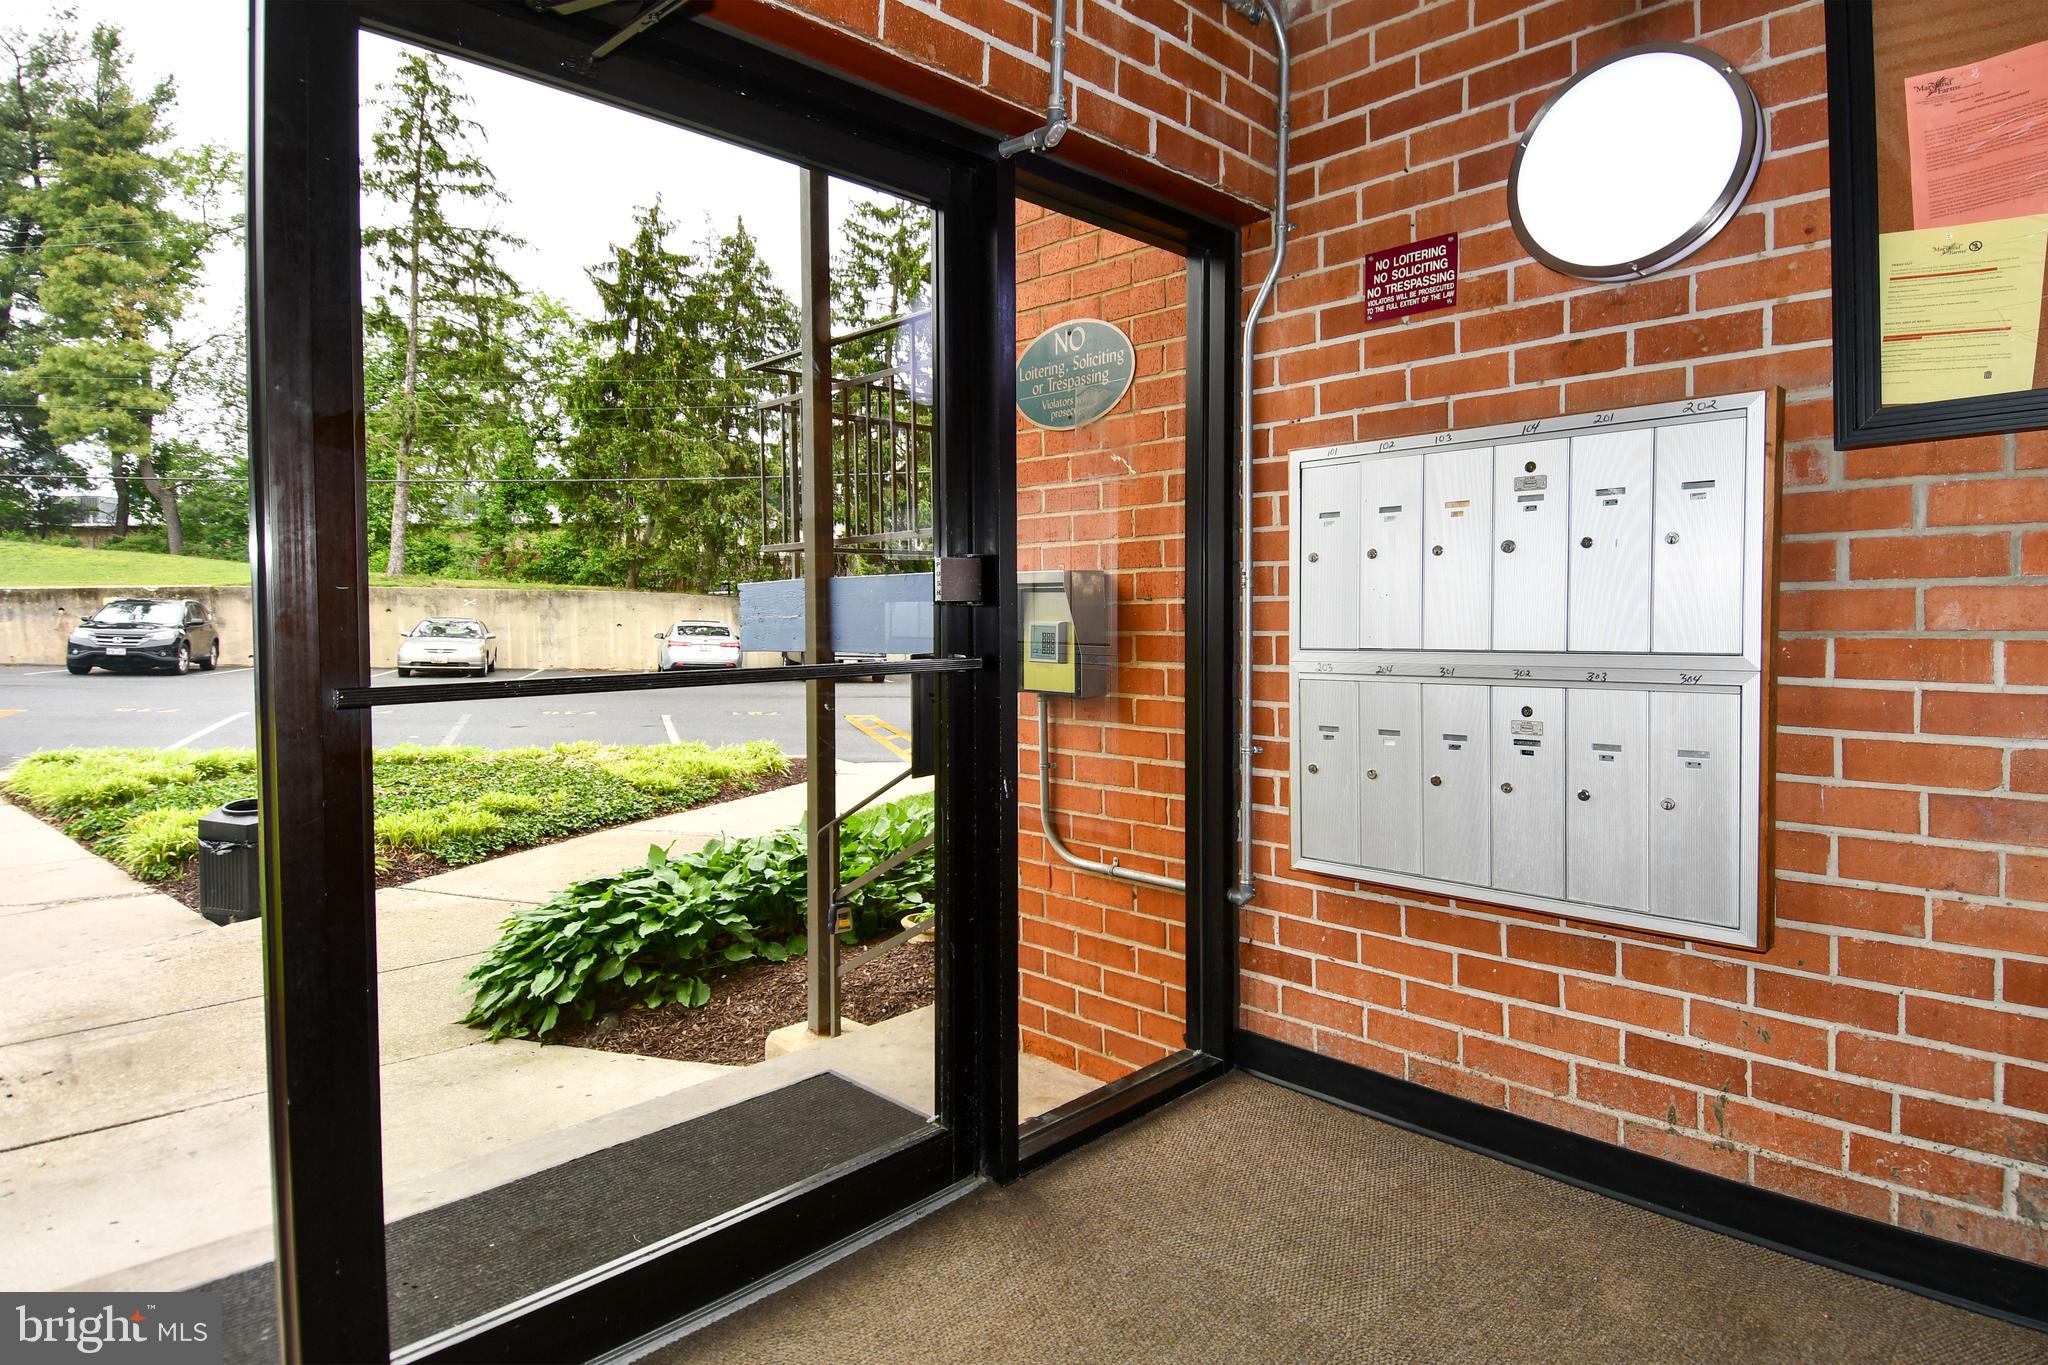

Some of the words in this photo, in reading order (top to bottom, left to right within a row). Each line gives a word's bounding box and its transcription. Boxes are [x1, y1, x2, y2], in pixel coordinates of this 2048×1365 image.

[1375, 258, 1390, 272] NO
[1393, 244, 1447, 267] LOITERING
[1373, 272, 1388, 285] NO
[1391, 257, 1449, 281] SOLICITING
[1367, 286, 1382, 299] NO
[1385, 269, 1455, 295] TRESPASSING
[1367, 296, 1395, 308] VIOLATORS
[1396, 292, 1408, 300] WILL
[1409, 290, 1417, 298] BE
[1418, 282, 1455, 295] PROSECUTED
[1375, 305, 1385, 313] THE
[1386, 303, 1399, 311] FULL
[1400, 298, 1420, 308] EXTENT
[1421, 295, 1429, 303] OF
[1431, 292, 1441, 300] THE
[1442, 290, 1455, 299] LAW
[1054, 326, 1086, 355] NO
[1019, 362, 1069, 382] Loitering,
[1073, 349, 1124, 371] Soliciting
[1032, 383, 1044, 396] or
[1047, 369, 1109, 393] Trespassing
[1041, 397, 1074, 410] Violators
[1682, 399, 1718, 414] 202
[1593, 412, 1615, 424] 201
[1521, 420, 1541, 436] 104
[1433, 433, 1453, 444] 103
[1327, 447, 1338, 457] 101
[1378, 441, 1395, 453] 102
[1317, 662, 1334, 672] 203
[1375, 664, 1394, 675] 204
[1439, 667, 1455, 678] 301
[1513, 669, 1532, 678] 302
[1586, 672, 1608, 682] 303
[1680, 673, 1703, 684] 304
